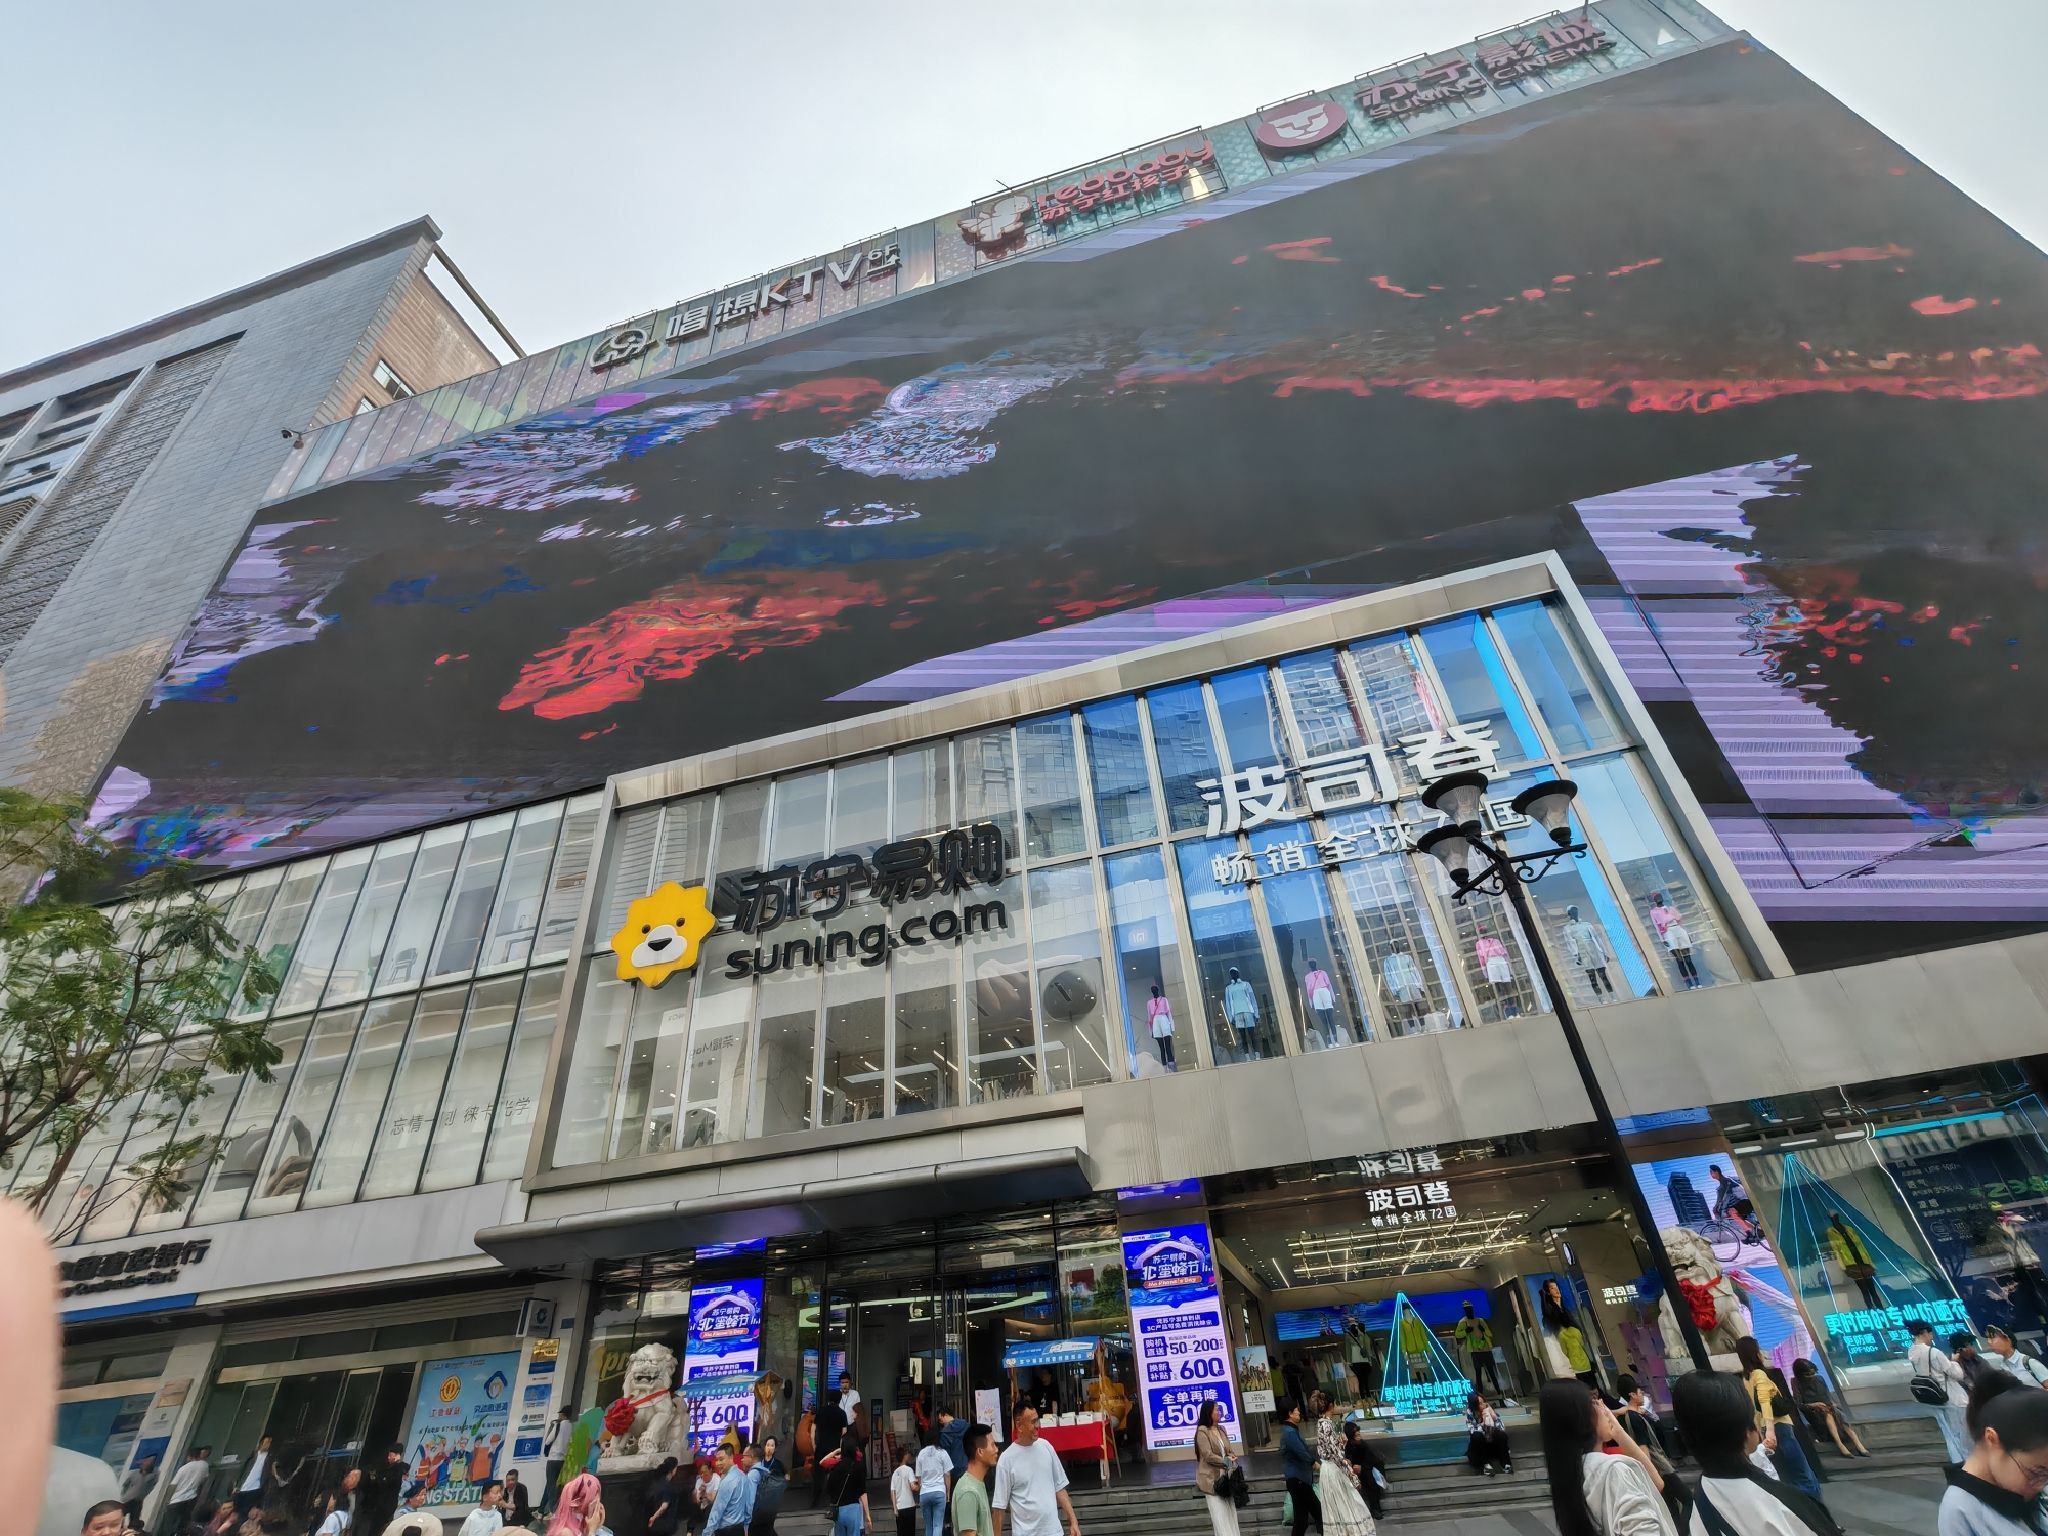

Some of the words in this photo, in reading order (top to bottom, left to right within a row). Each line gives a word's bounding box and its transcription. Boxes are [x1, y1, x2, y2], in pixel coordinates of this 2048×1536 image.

[1370, 74, 1487, 120] SUNING
[1493, 38, 1617, 81] CINEMA
[1195, 720, 1510, 838] 波司登
[732, 824, 1004, 935] 苏宁易购
[724, 898, 1007, 979] suning.com
[1365, 1181, 1452, 1212] 波司登
[1371, 1205, 1457, 1227] 畅销全球72国
[1601, 1284, 1638, 1298] 波司登
[1149, 1363, 1168, 1372] 换新
[1150, 1372, 1169, 1381] 补贴
[1180, 1357, 1224, 1379] 600
[1162, 1389, 1218, 1405] 全单再降
[712, 1404, 749, 1424] 600
